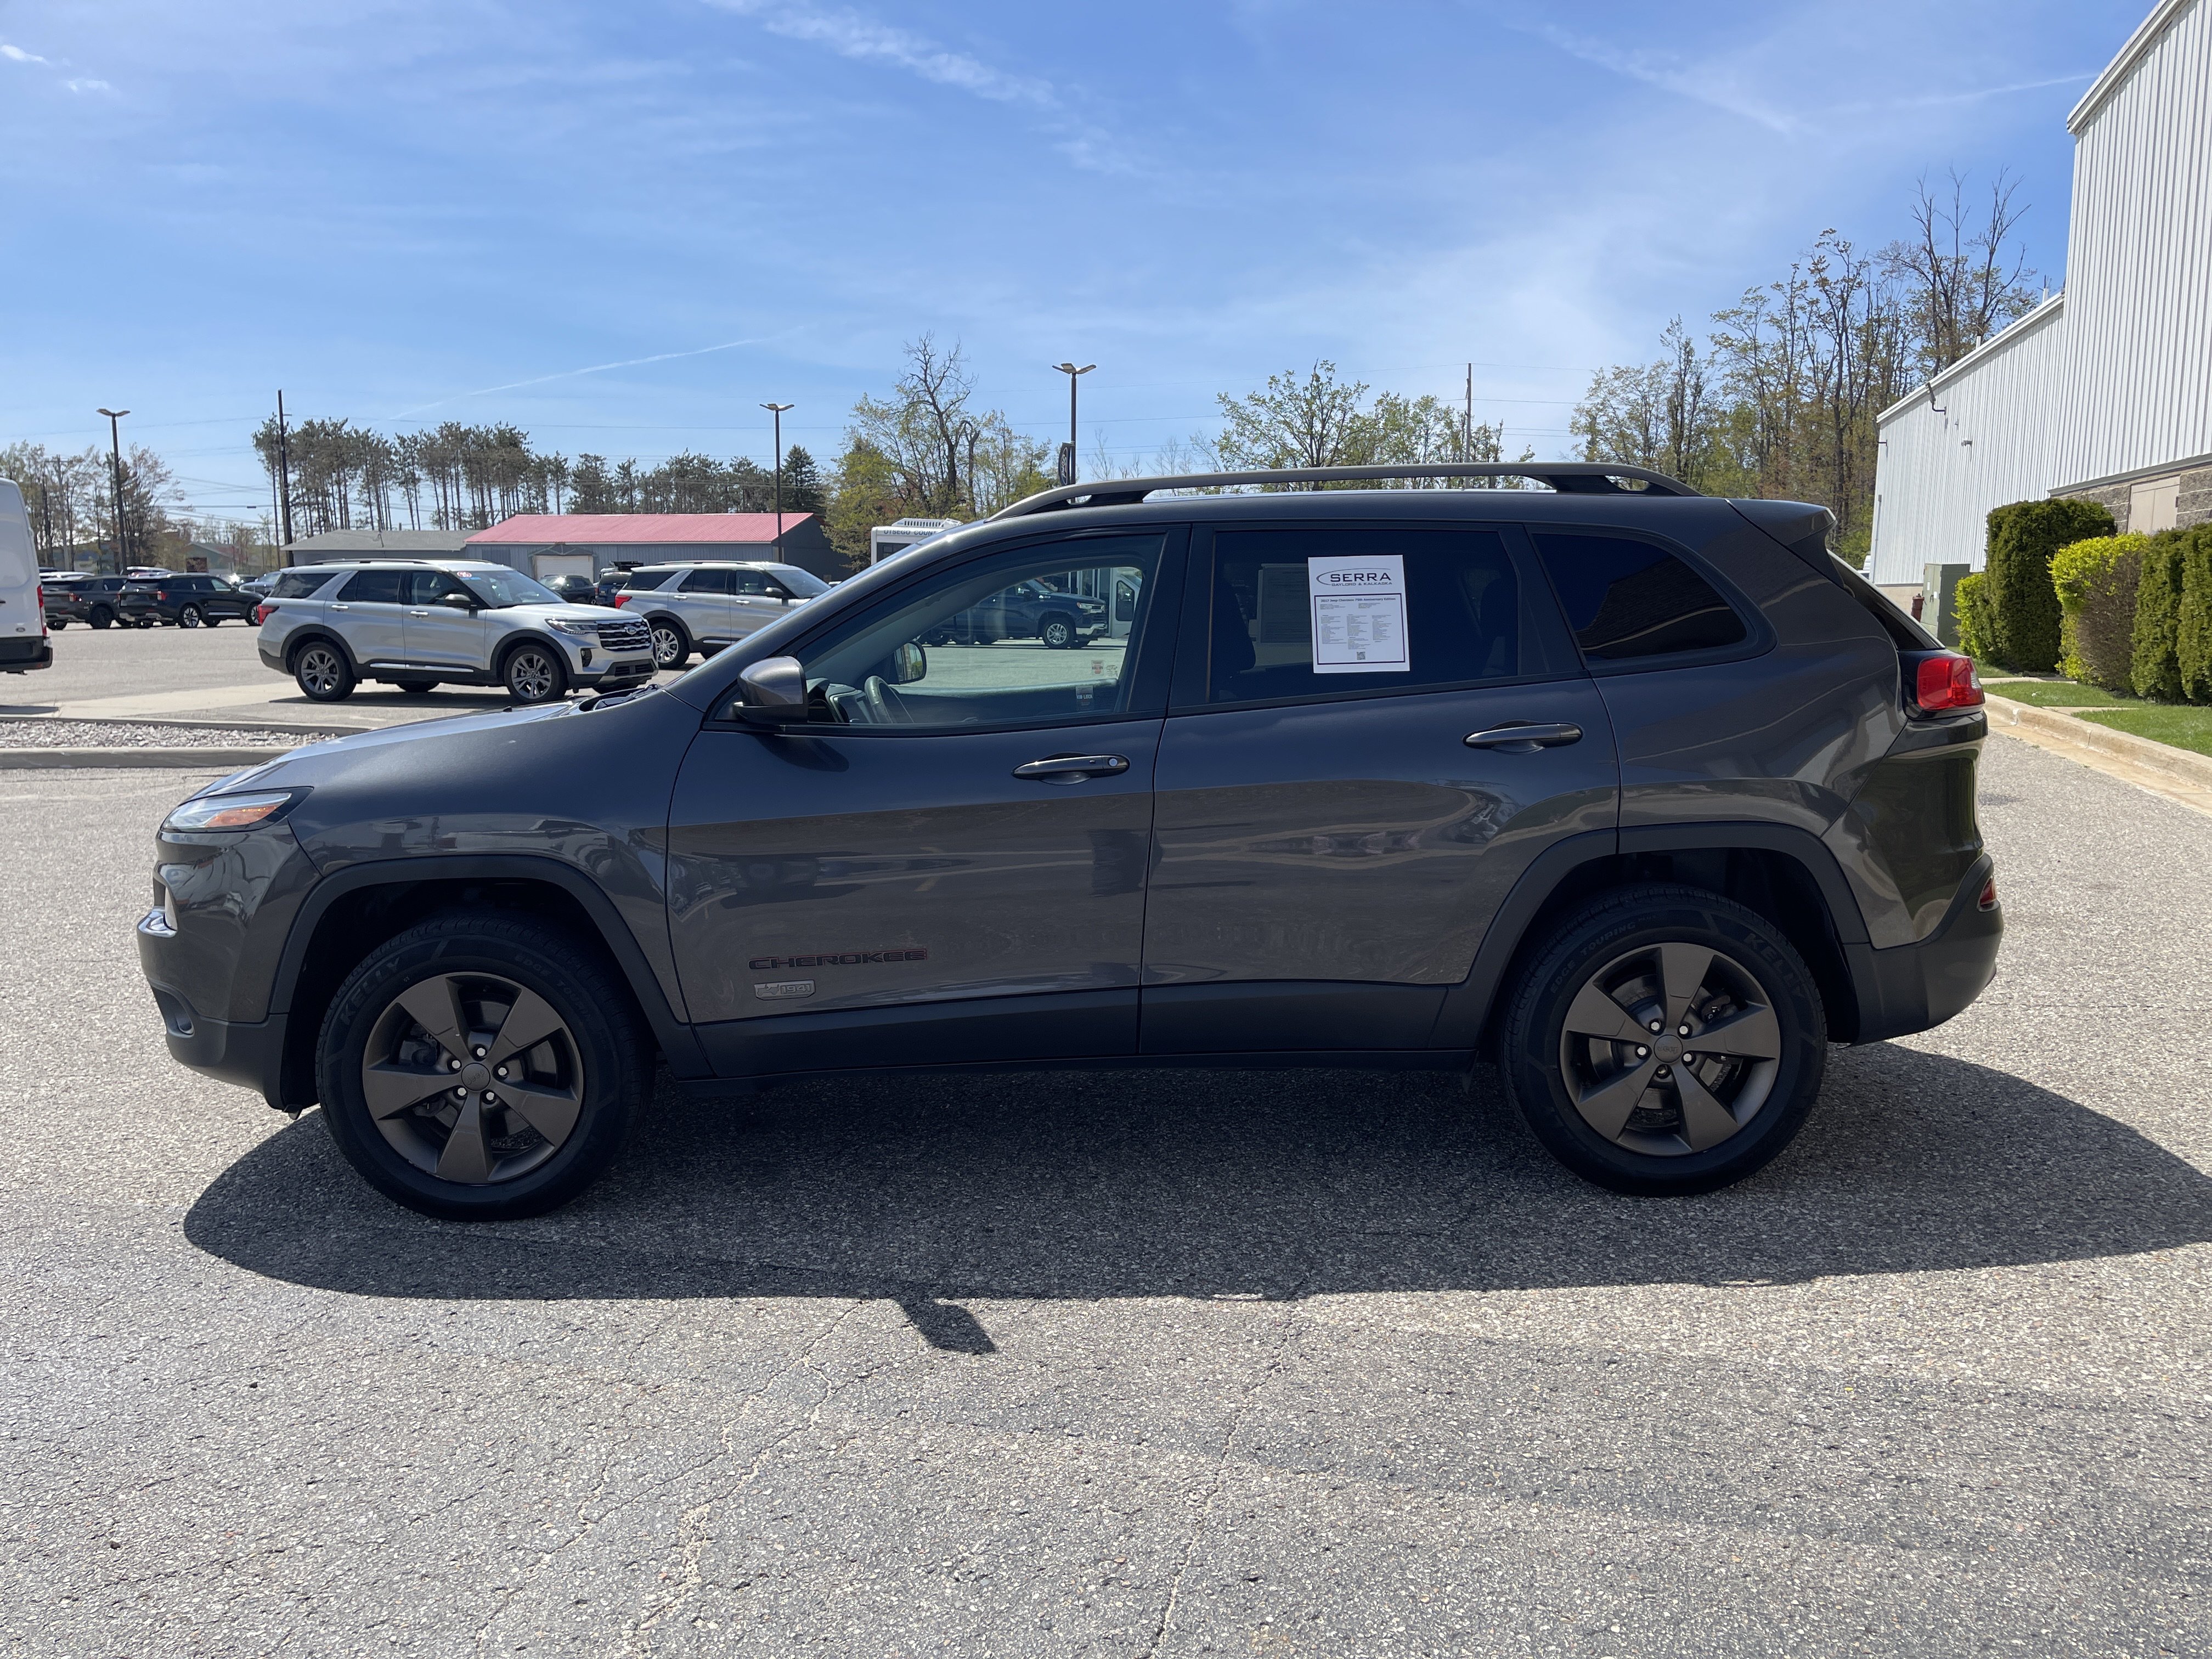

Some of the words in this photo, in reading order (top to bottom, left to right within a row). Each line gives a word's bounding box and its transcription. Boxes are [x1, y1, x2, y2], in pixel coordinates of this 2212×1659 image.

[1330, 572, 1391, 583] SERRA
[748, 949, 927, 970] CHEROKEE
[1743, 933, 1807, 998] KELLY
[340, 956, 400, 1025] KELLY
[780, 984, 811, 995] 1941
[466, 1069, 486, 1086] Jeep
